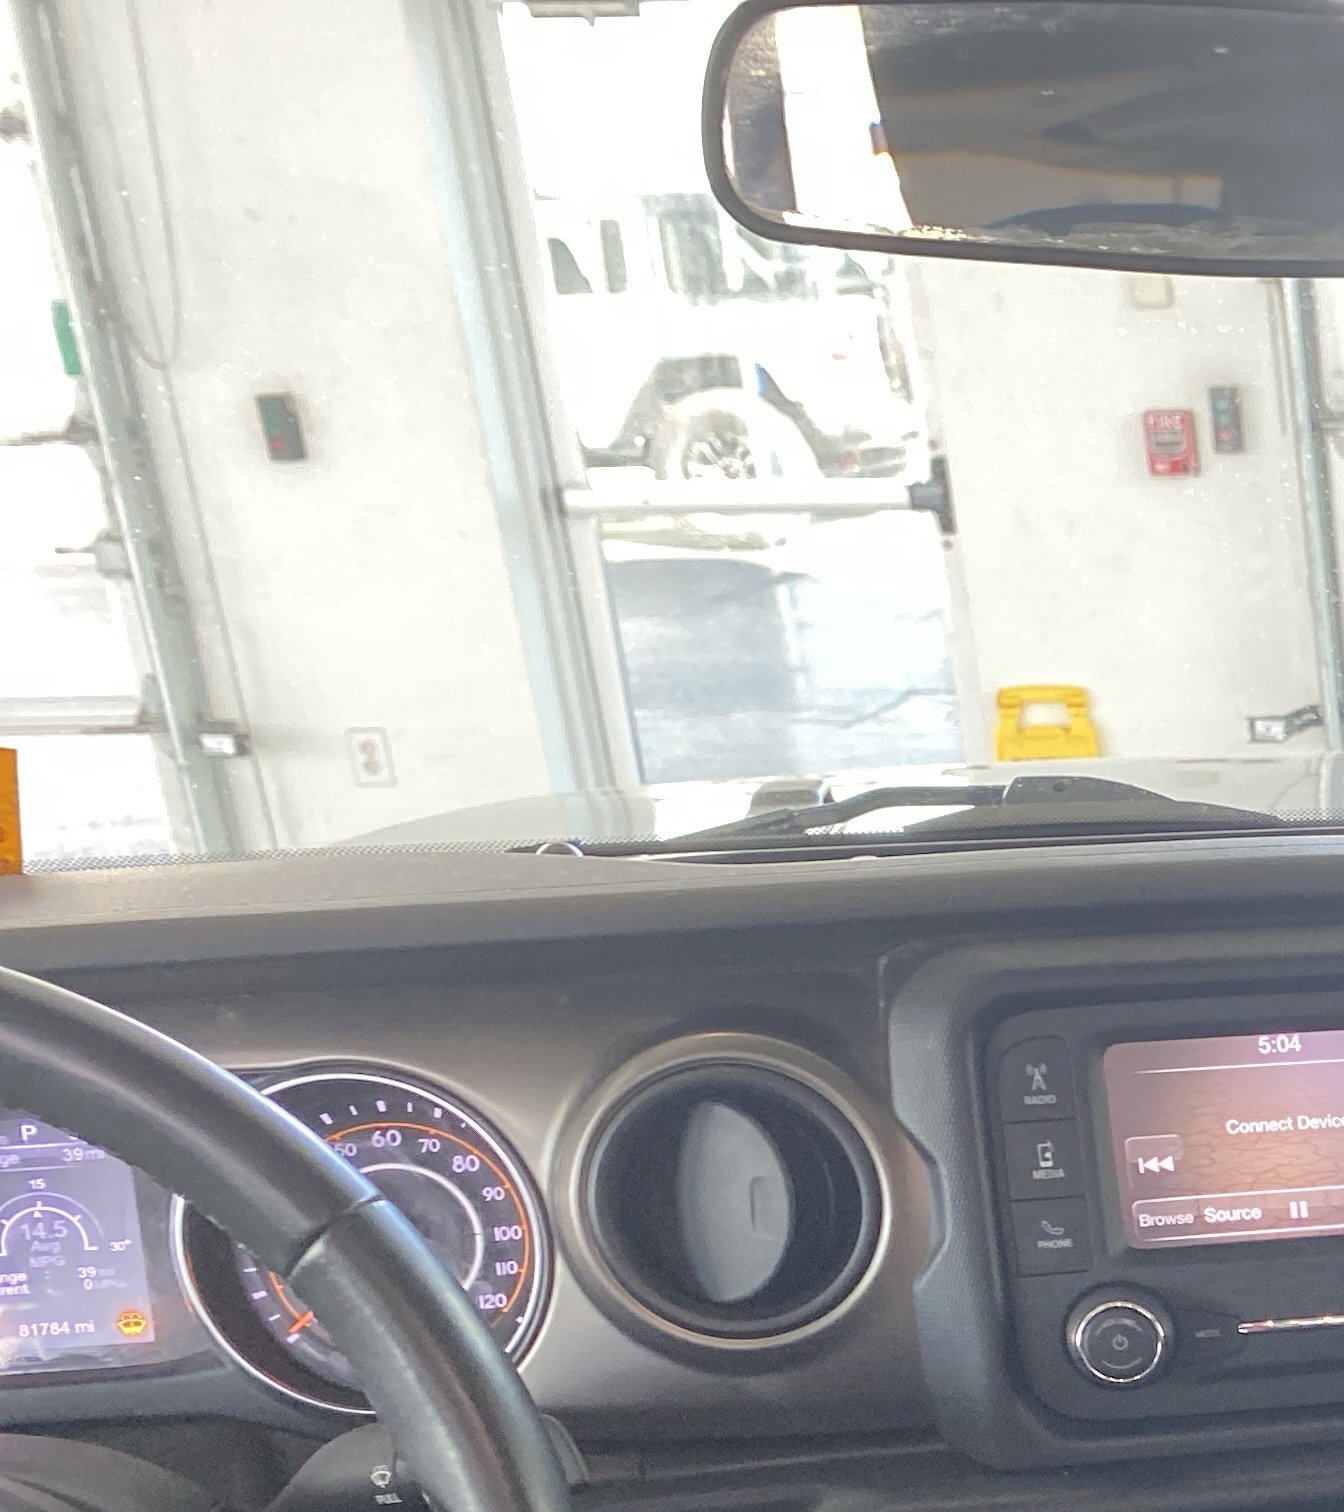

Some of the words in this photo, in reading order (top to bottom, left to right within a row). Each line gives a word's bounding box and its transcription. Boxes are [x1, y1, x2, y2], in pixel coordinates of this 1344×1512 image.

[1257, 1034, 1303, 1055] 5:04
[20, 1124, 38, 1143] P
[1225, 1116, 1294, 1136] Connect
[371, 1129, 402, 1148] 60
[418, 1138, 441, 1153] 70
[451, 1154, 480, 1173] 80
[28, 1178, 46, 1190] 15
[482, 1186, 506, 1202] 90
[1138, 1211, 1195, 1228] Browse
[1203, 1205, 1263, 1223] Source
[20, 1220, 68, 1241] 14.5
[493, 1225, 523, 1242] 100
[78, 1266, 97, 1279] 39
[494, 1260, 519, 1276] 110
[478, 1293, 507, 1310] 120
[19, 1321, 70, 1338] 81784
[74, 1319, 95, 1334] mi
